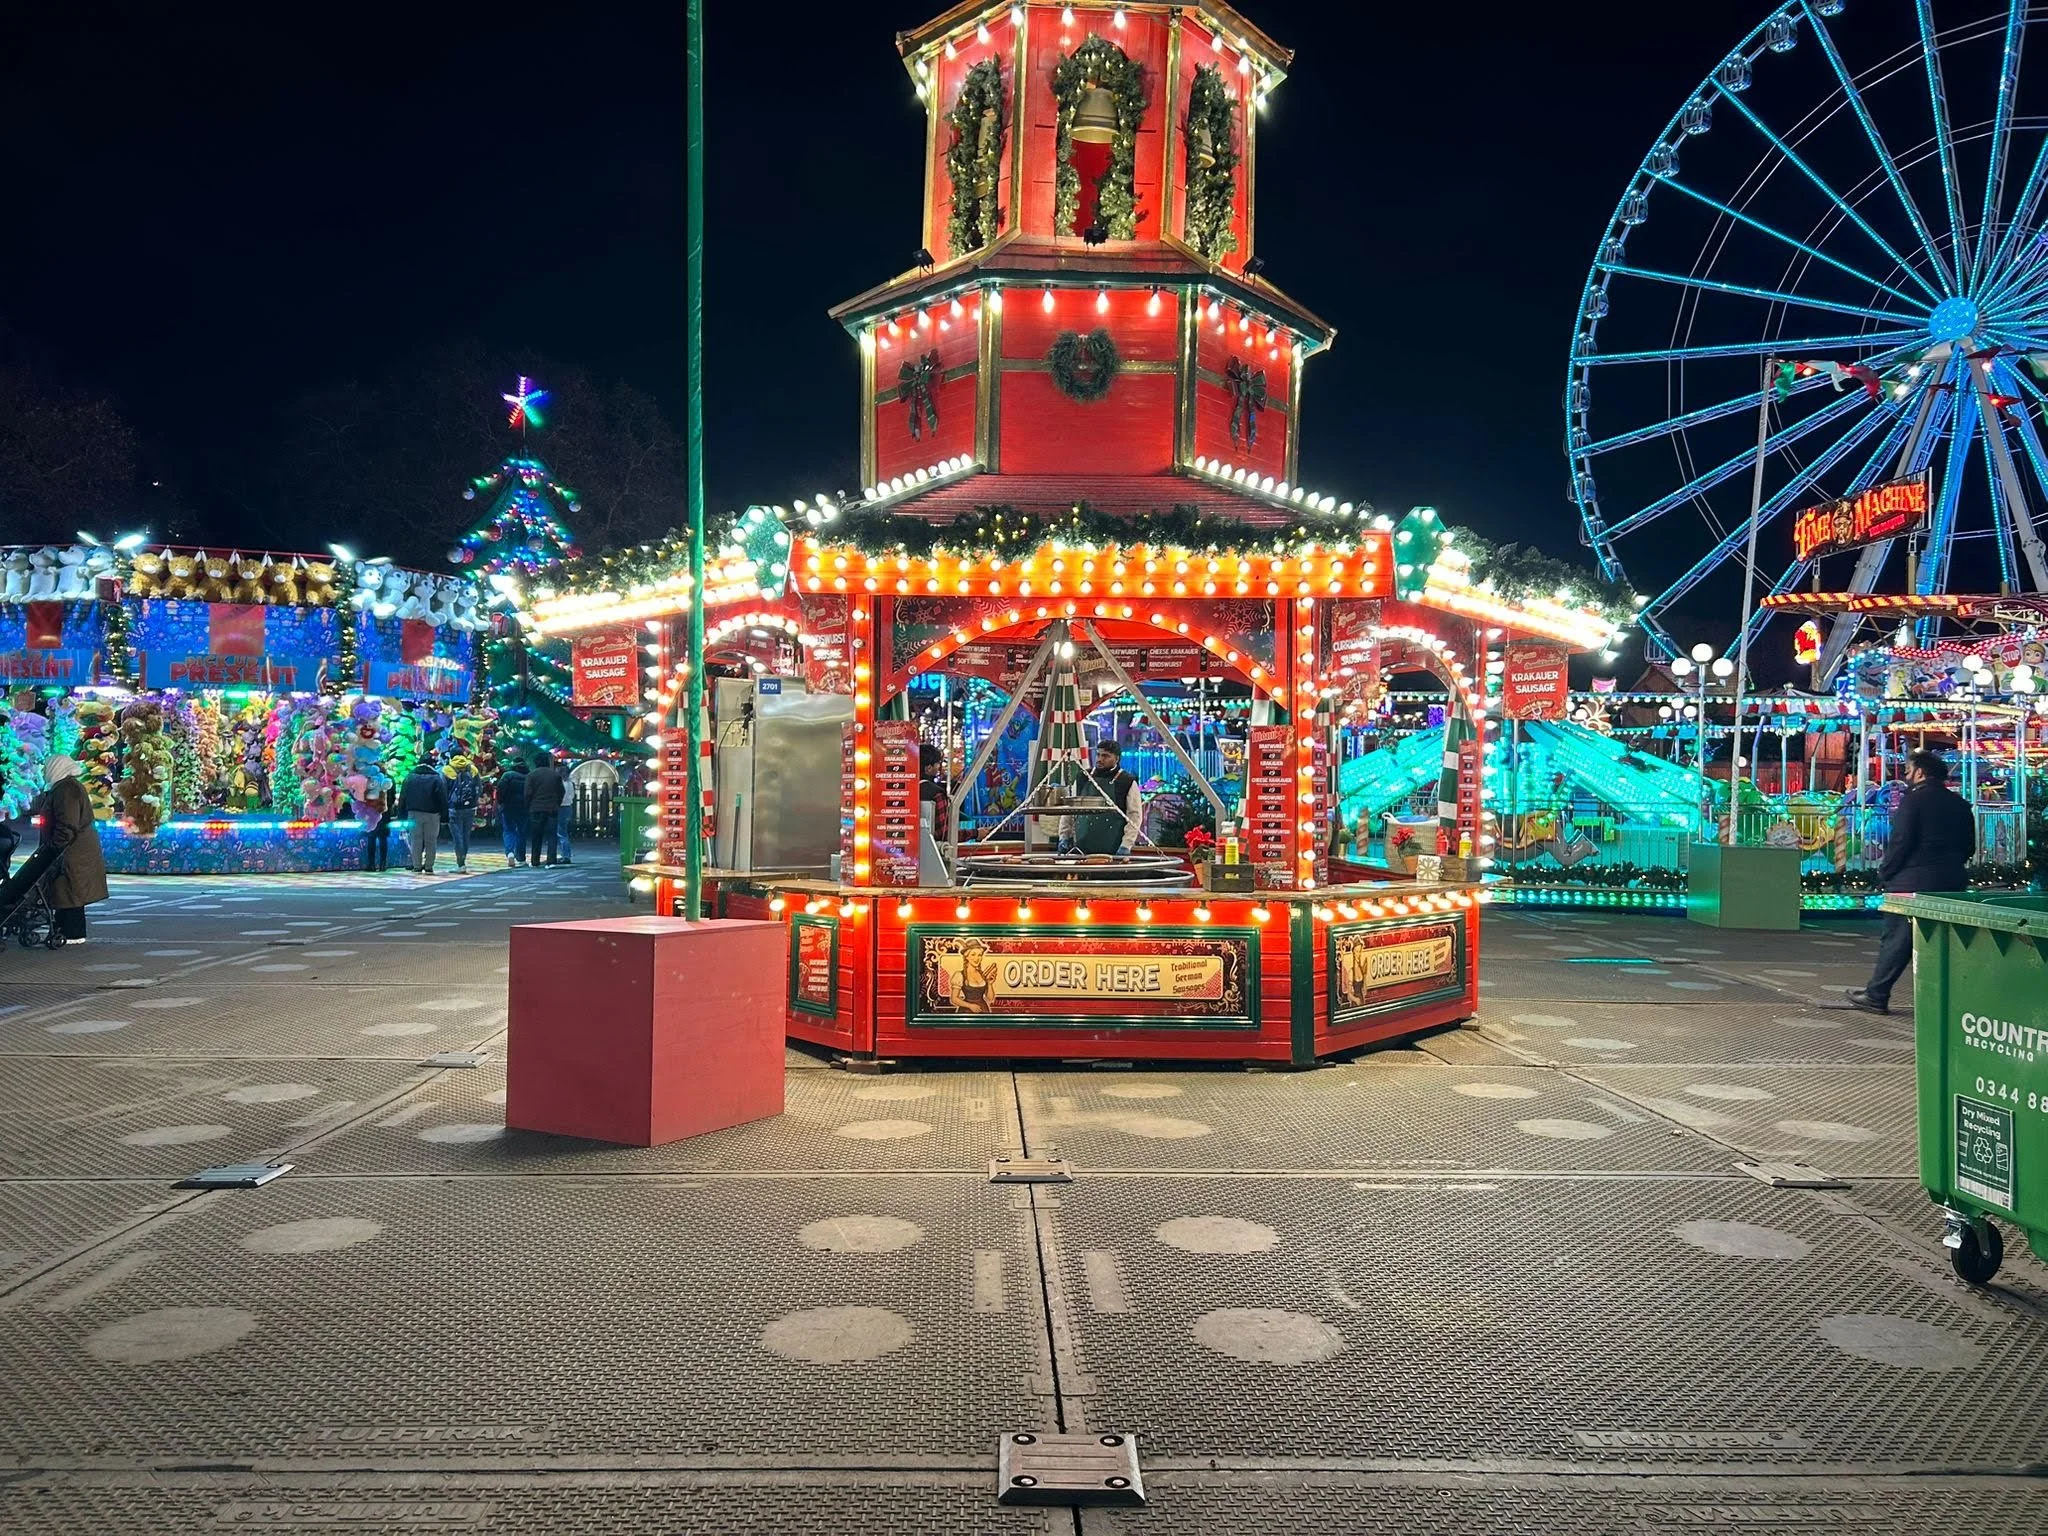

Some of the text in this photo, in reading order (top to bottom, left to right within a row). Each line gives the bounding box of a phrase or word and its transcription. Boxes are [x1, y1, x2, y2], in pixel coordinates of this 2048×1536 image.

[1854, 480, 1926, 540] MACHINE
[580, 654, 629, 668] KRAKAUER
[2002, 650, 2020, 663] STOP
[169, 661, 298, 685] PRESENT
[585, 667, 627, 679] SAUSAGE
[1511, 670, 1559, 683] KRAKAUER
[1515, 682, 1556, 694] SAUSAGE
[1171, 959, 1207, 972] Traditional
[1370, 950, 1404, 980] ORDER
[1406, 948, 1431, 975] HERE
[1003, 959, 1161, 993] ORDER HERE
[1175, 972, 1203, 982] German
[1172, 983, 1206, 994] Sausages
[1965, 1035, 2034, 1062] RECYCLING
[1975, 1076, 2020, 1104] 0344
[1962, 1106, 2001, 1127] Dry Mixed
[1963, 1118, 2002, 1141] Recycling
